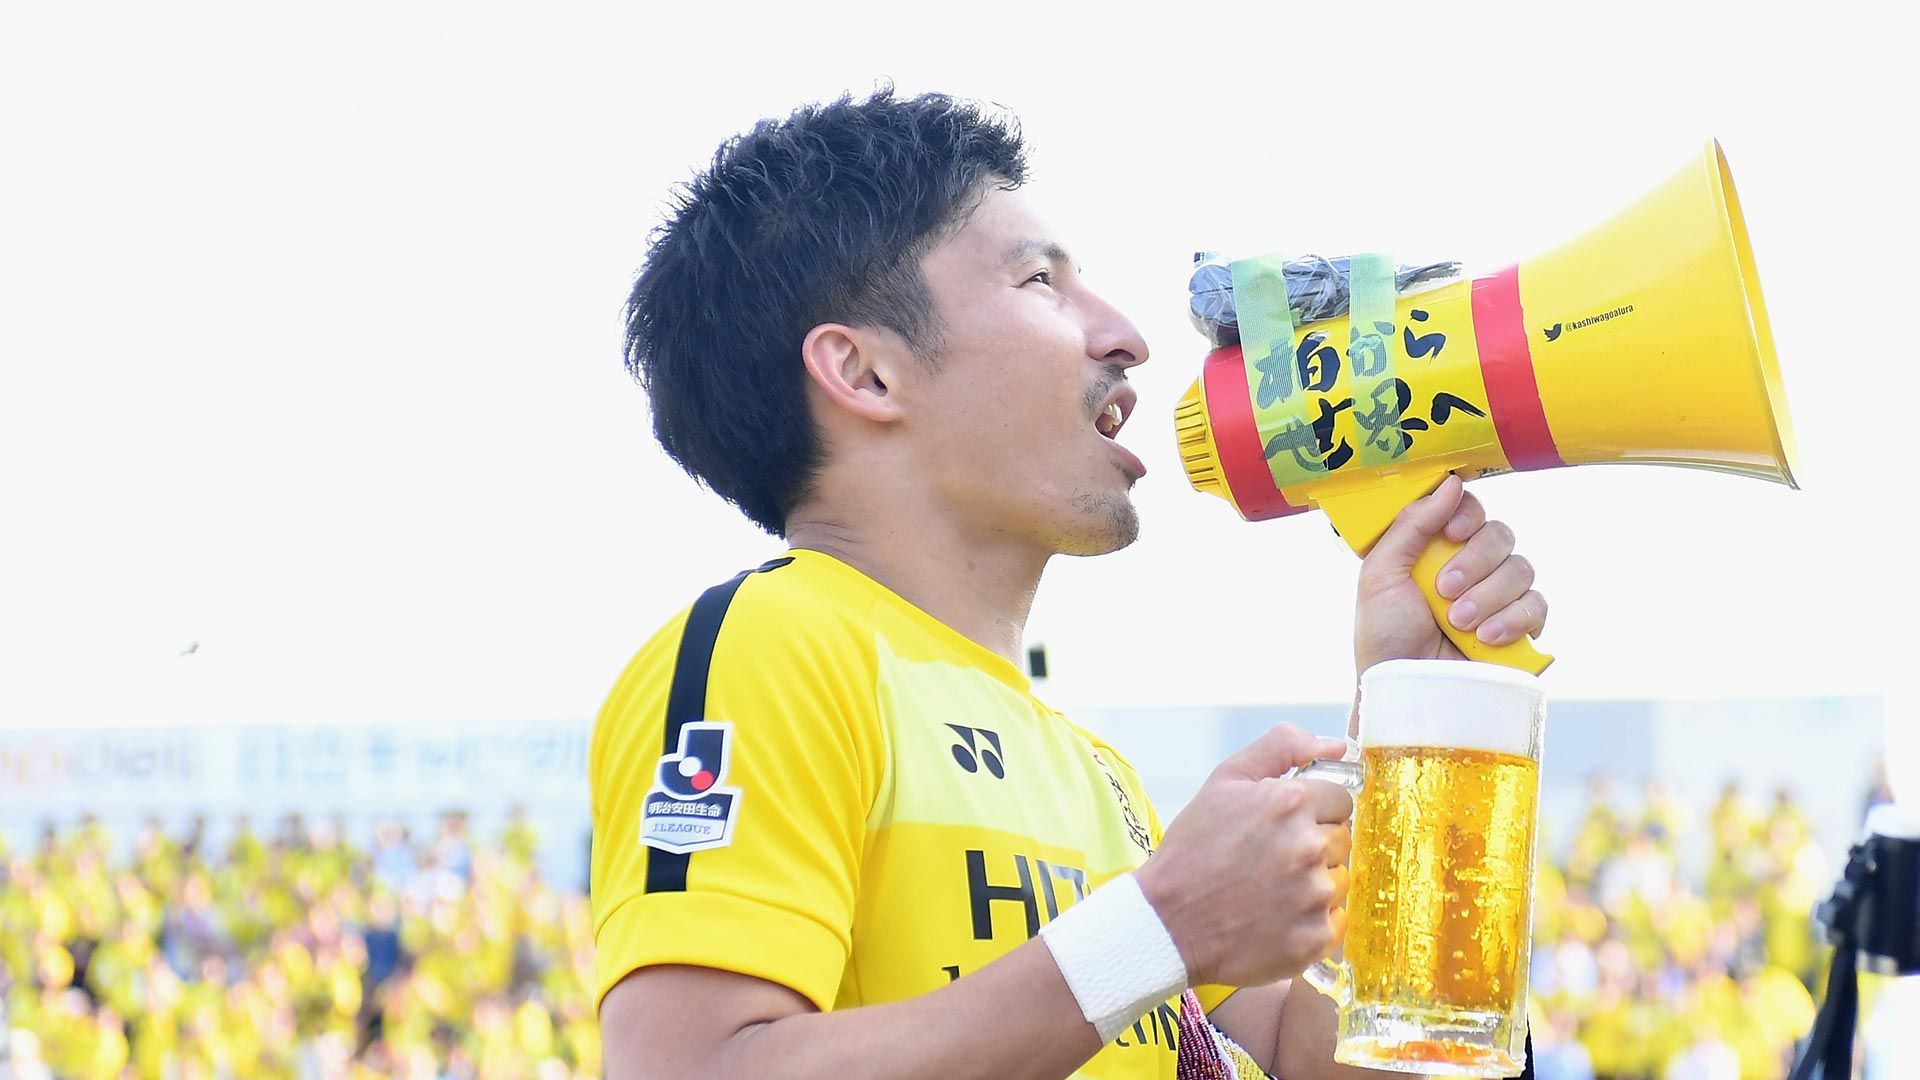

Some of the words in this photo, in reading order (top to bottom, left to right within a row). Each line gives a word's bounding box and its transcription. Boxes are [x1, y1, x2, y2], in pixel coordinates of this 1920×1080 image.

[1565, 304, 1634, 333] @kashiwagoalura
[648, 801, 722, 818] 明治安田生命
[965, 848, 1092, 942] HIT
